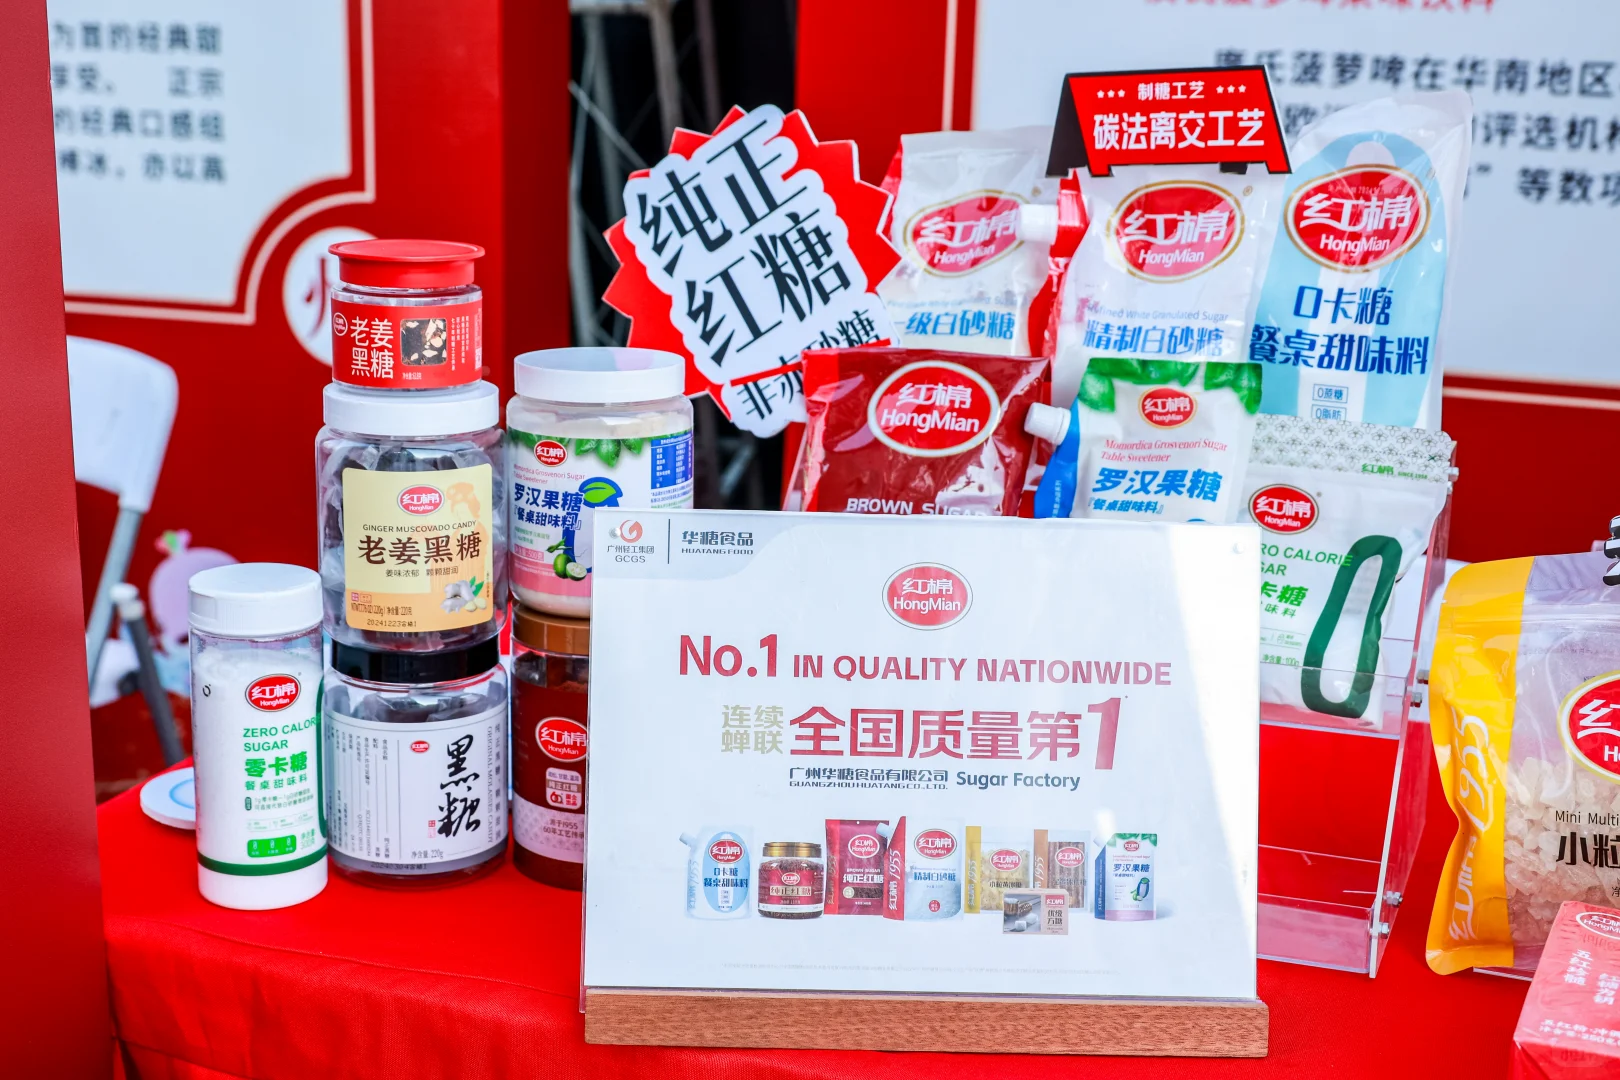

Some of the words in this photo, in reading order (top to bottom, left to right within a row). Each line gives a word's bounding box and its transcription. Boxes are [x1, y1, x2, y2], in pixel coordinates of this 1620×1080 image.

[1137, 80, 1205, 101] 制糖工艺
[1092, 108, 1265, 151] 碳法离交工艺
[636, 119, 808, 278] 纯正
[1299, 193, 1413, 232] 红棉
[917, 208, 1020, 248] 红棉
[1120, 210, 1231, 246] 红棉
[933, 244, 996, 265] HongMian
[1319, 234, 1391, 257] HongMian
[1138, 249, 1205, 268] HongMian
[685, 208, 851, 368] 红糖
[894, 309, 1016, 340] 一级白砂糖
[1126, 309, 1151, 319] White
[1152, 310, 1200, 321] Granulated
[1202, 311, 1229, 323] Sugar
[350, 316, 394, 349] 老姜
[1082, 320, 1225, 357] 精制白砂糖
[1249, 323, 1430, 376] 餐桌甜味料
[350, 347, 395, 380] 黑糖
[895, 382, 973, 410] 红棉
[1317, 388, 1344, 401] 0蔗糖
[1143, 397, 1190, 413] 红棉
[880, 408, 980, 434] HongMian
[1152, 413, 1184, 423] HongMian
[536, 445, 564, 458] 红棉
[1104, 439, 1153, 450] Momordica
[1154, 438, 1202, 450] Grosvenori
[1201, 438, 1228, 452] Sugar
[1101, 451, 1126, 462] Table
[1127, 453, 1171, 463] Sweetener
[535, 468, 566, 479] Grosvenori
[566, 472, 585, 482] Sugar
[1092, 467, 1223, 502] 罗汉果糖
[402, 492, 440, 505] 红棉
[514, 482, 583, 513] 罗汉果糖
[846, 498, 914, 515] BROWN
[1255, 495, 1312, 519] 红棉
[408, 504, 434, 512] HongMian
[362, 523, 394, 533] GINGER
[395, 523, 450, 533] MUSCOVADO
[451, 520, 477, 531] CANDY
[1264, 514, 1301, 528] HongMian
[357, 530, 482, 566] 老姜黑糖
[681, 530, 754, 547] 华糖食品
[606, 545, 655, 554] 广州轻工集团
[615, 554, 646, 563] GCGS
[1259, 543, 1280, 557] RO
[1283, 545, 1354, 567] CALORIE
[385, 568, 420, 578] 姜味浓郁
[1259, 562, 1287, 576] GAR
[901, 577, 954, 596] 红棉
[1259, 580, 1308, 607] 卡糖
[893, 596, 961, 614] HongMian
[679, 633, 778, 678] No.1
[793, 654, 823, 678] IN
[833, 655, 967, 682] QUALITY
[977, 658, 1172, 686] NATIONWIDE
[250, 682, 297, 699] 红棉
[259, 697, 290, 707] HongMian
[721, 704, 784, 730] 连续
[242, 726, 278, 738] ZERO
[540, 727, 587, 747] 红棉
[789, 697, 1122, 770] 全国质量第1
[243, 739, 289, 752] SUGAR
[547, 744, 579, 755] HongMian
[721, 730, 784, 755] 蝉联
[1603, 745, 1620, 762] H
[244, 750, 308, 778] 零卡糖
[244, 773, 308, 792] 餐桌甜味料
[789, 767, 948, 782] 广州华糖食品有限公司
[956, 770, 1008, 790] Sugar
[1013, 772, 1081, 791] Factory
[437, 733, 482, 838] 黑糖
[1554, 810, 1582, 823] Mini
[1587, 812, 1620, 826] Multi
[889, 848, 901, 880] 1955
[1113, 863, 1151, 873] 罗汉果糖
[703, 877, 748, 888] 餐桌甜味料
[842, 873, 884, 884] 纯正红糖
[770, 885, 812, 896] 纯正红糖
